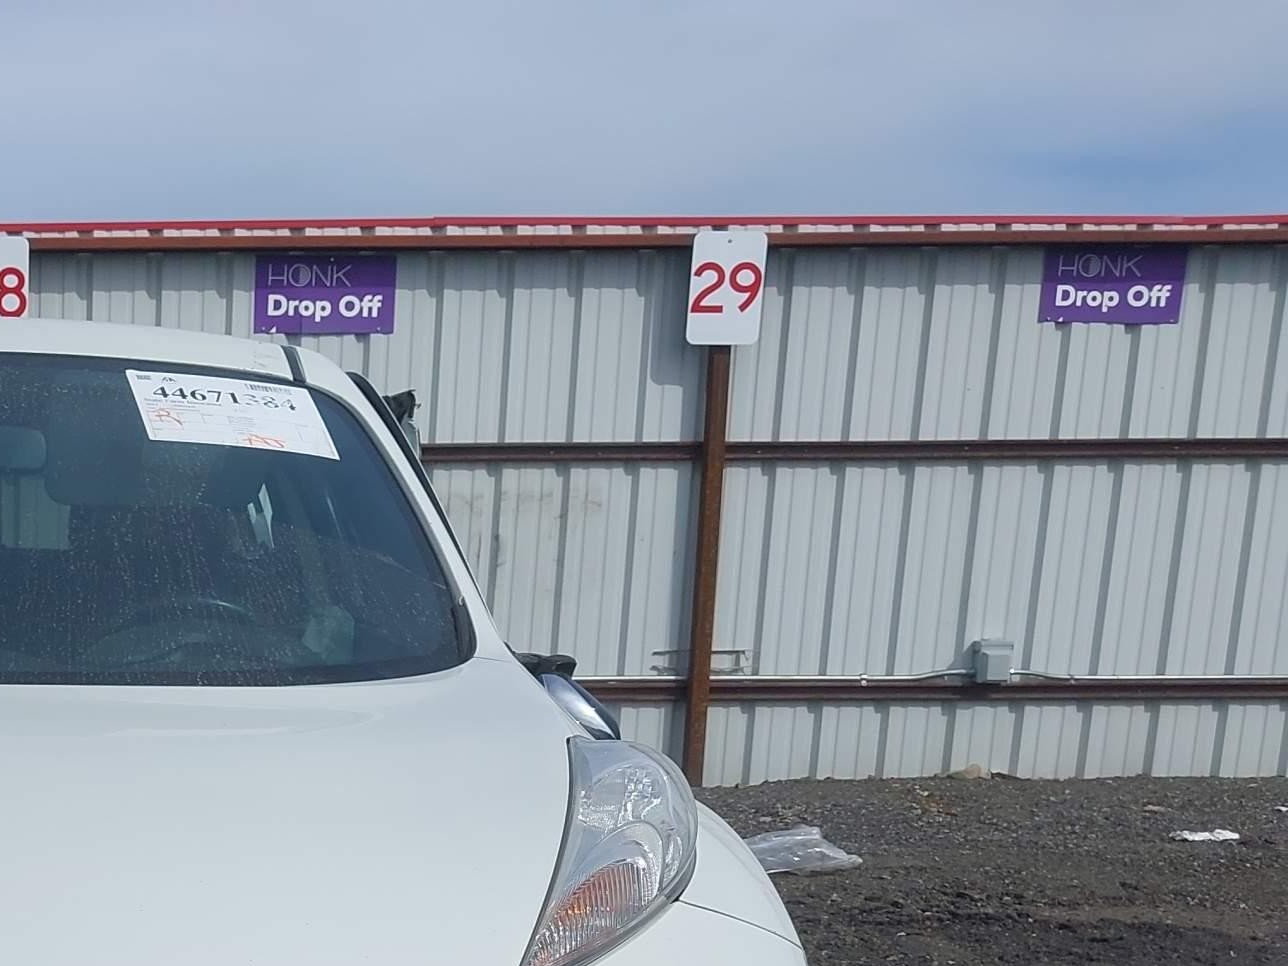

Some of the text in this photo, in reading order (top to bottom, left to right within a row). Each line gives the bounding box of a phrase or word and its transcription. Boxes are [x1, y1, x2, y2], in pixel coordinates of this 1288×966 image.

[267, 263, 353, 287] HONK
[1057, 254, 1143, 277] HONK
[690, 261, 762, 313] 29
[1055, 284, 1173, 312] Drop Off
[267, 294, 383, 322] Drop Off
